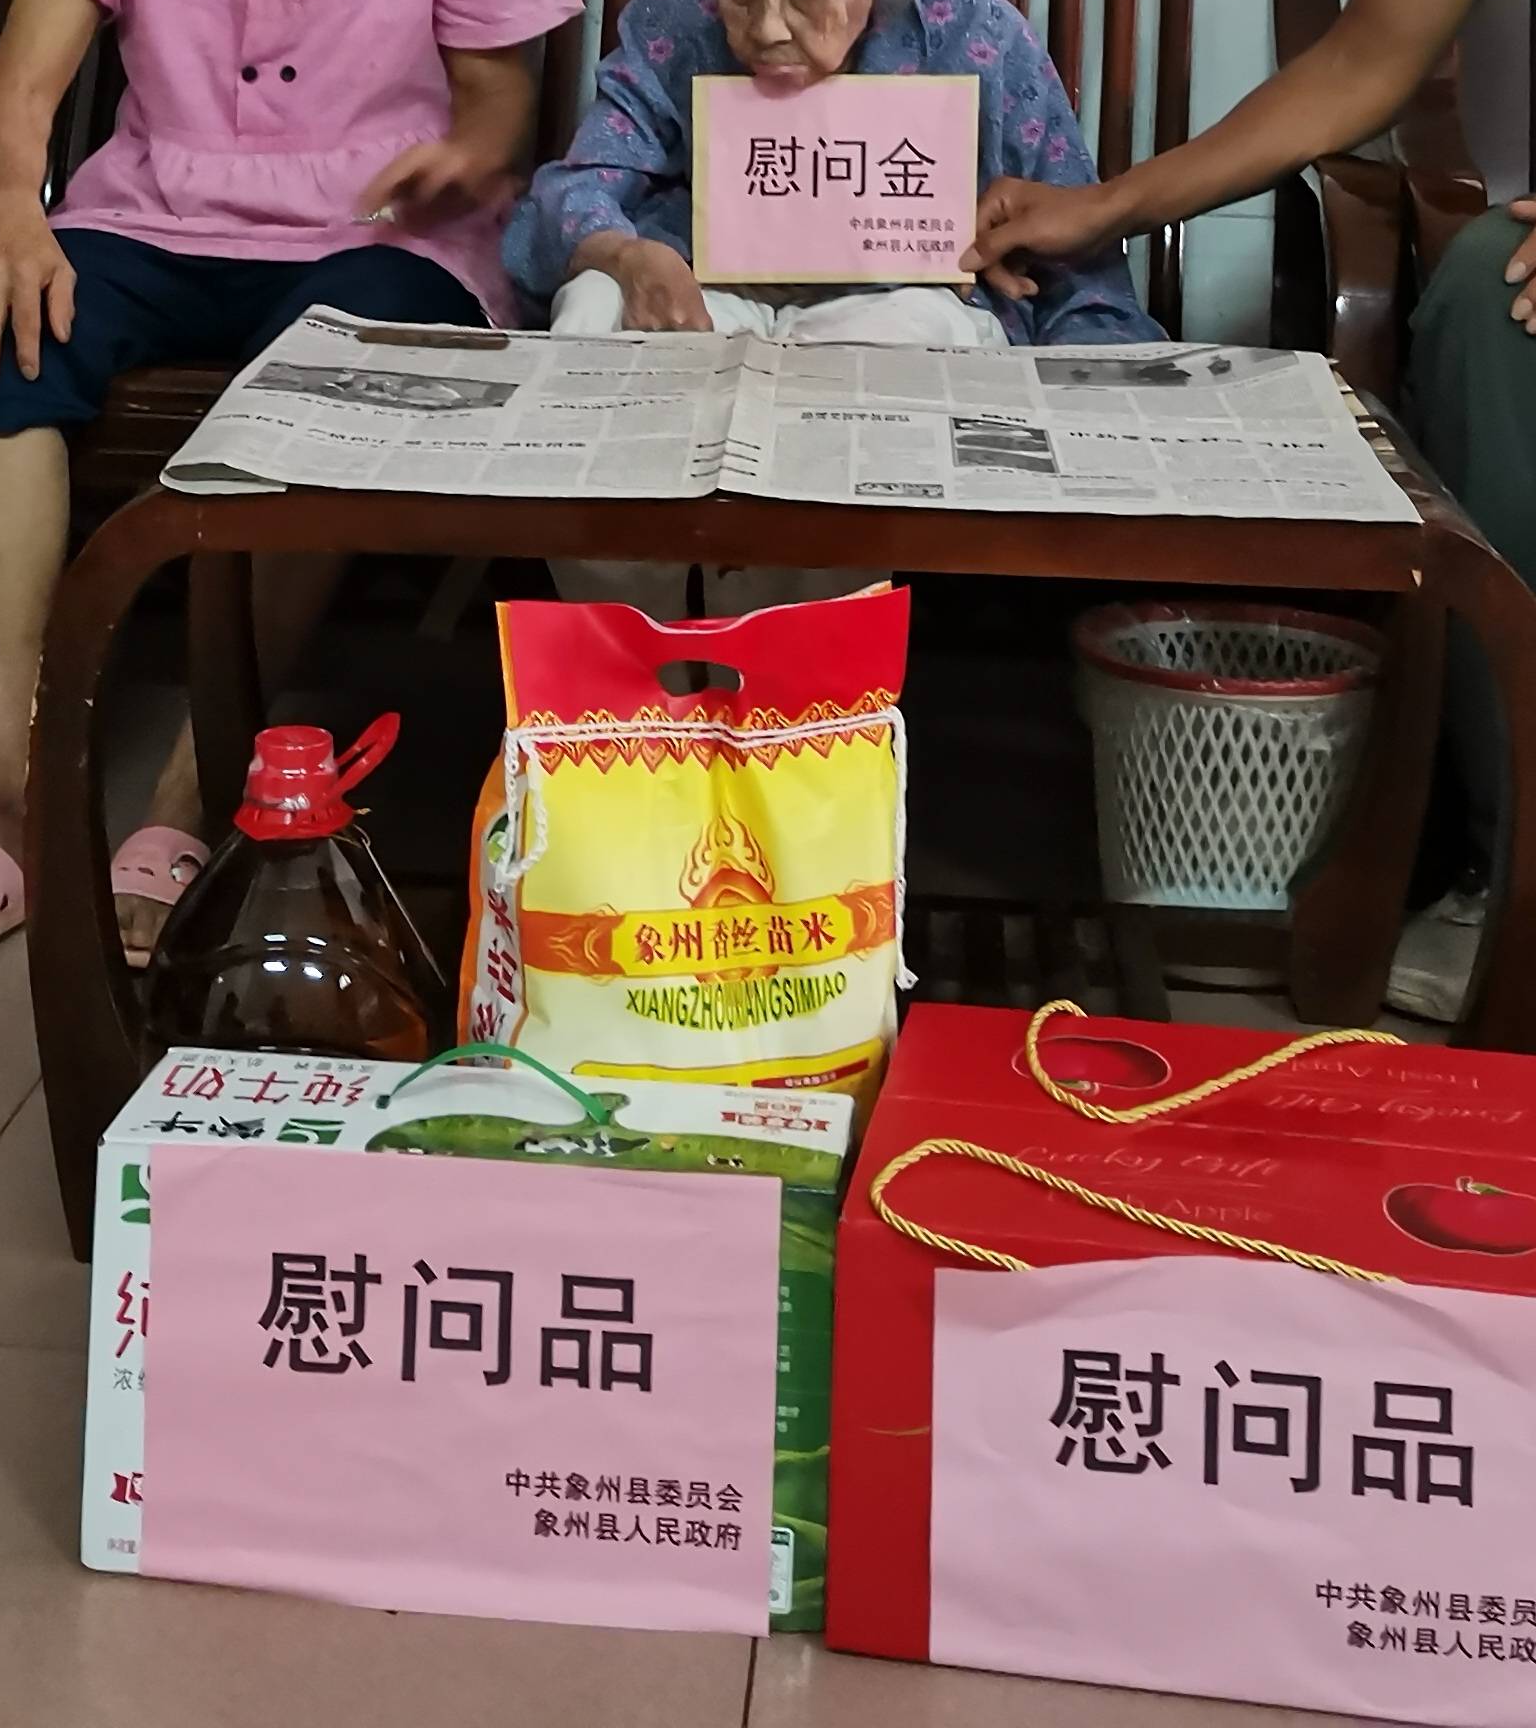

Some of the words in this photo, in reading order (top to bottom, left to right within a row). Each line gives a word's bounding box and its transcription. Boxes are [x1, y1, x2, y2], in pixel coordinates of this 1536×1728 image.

[744, 135, 938, 199] 慰问金
[862, 238, 955, 253] 象州县人民政府
[634, 911, 837, 965] 象州香丝苗米
[161, 1065, 371, 1107] 纯牛奶
[257, 1251, 655, 1393] 慰问品
[1049, 1348, 1476, 1507] 慰问品
[505, 1467, 744, 1513] 中共象州县委员会
[533, 1507, 742, 1551] 象州县人民政府
